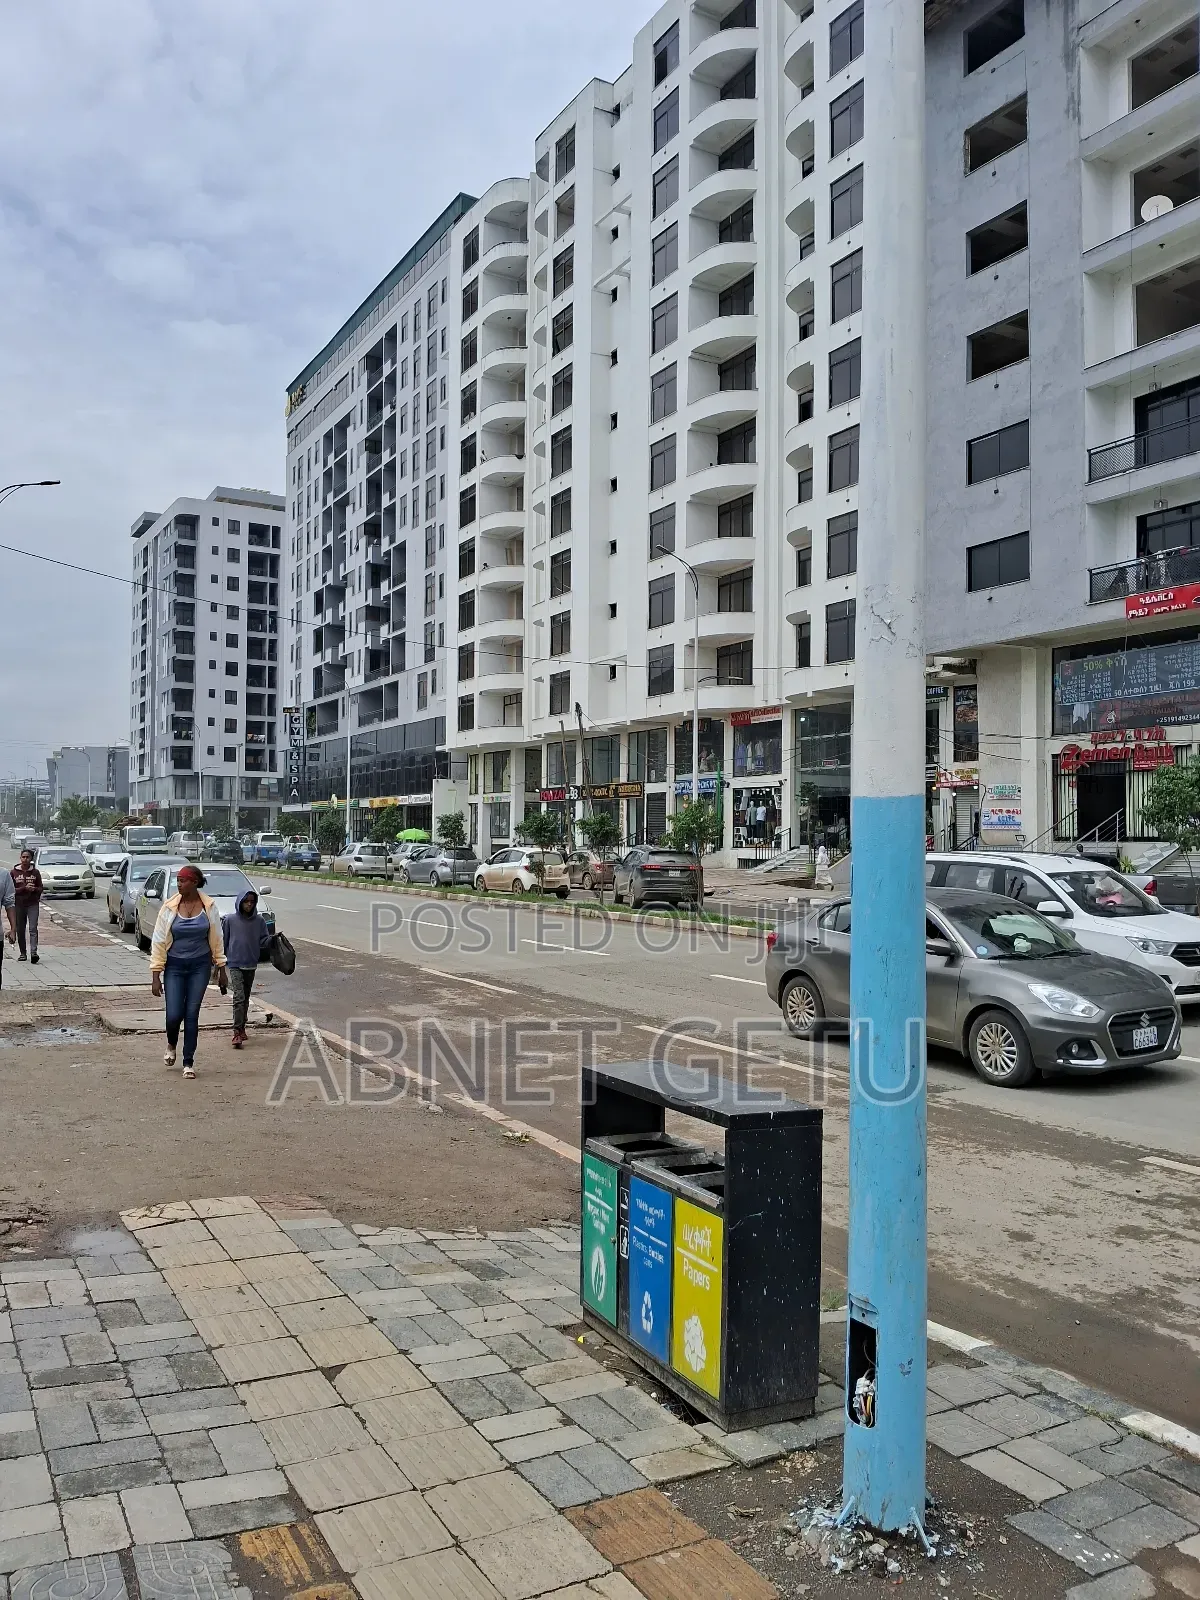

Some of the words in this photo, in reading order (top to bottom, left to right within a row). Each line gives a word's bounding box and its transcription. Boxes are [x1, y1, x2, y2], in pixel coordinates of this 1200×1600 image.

[1083, 660, 1103, 672] 50%
[1183, 679, 1196, 689] 199
[291, 716, 300, 747] GYM
[1060, 744, 1131, 770] Zemen
[1133, 743, 1175, 760] Bank
[291, 765, 299, 796] SPA
[683, 1257, 710, 1291] Papers
